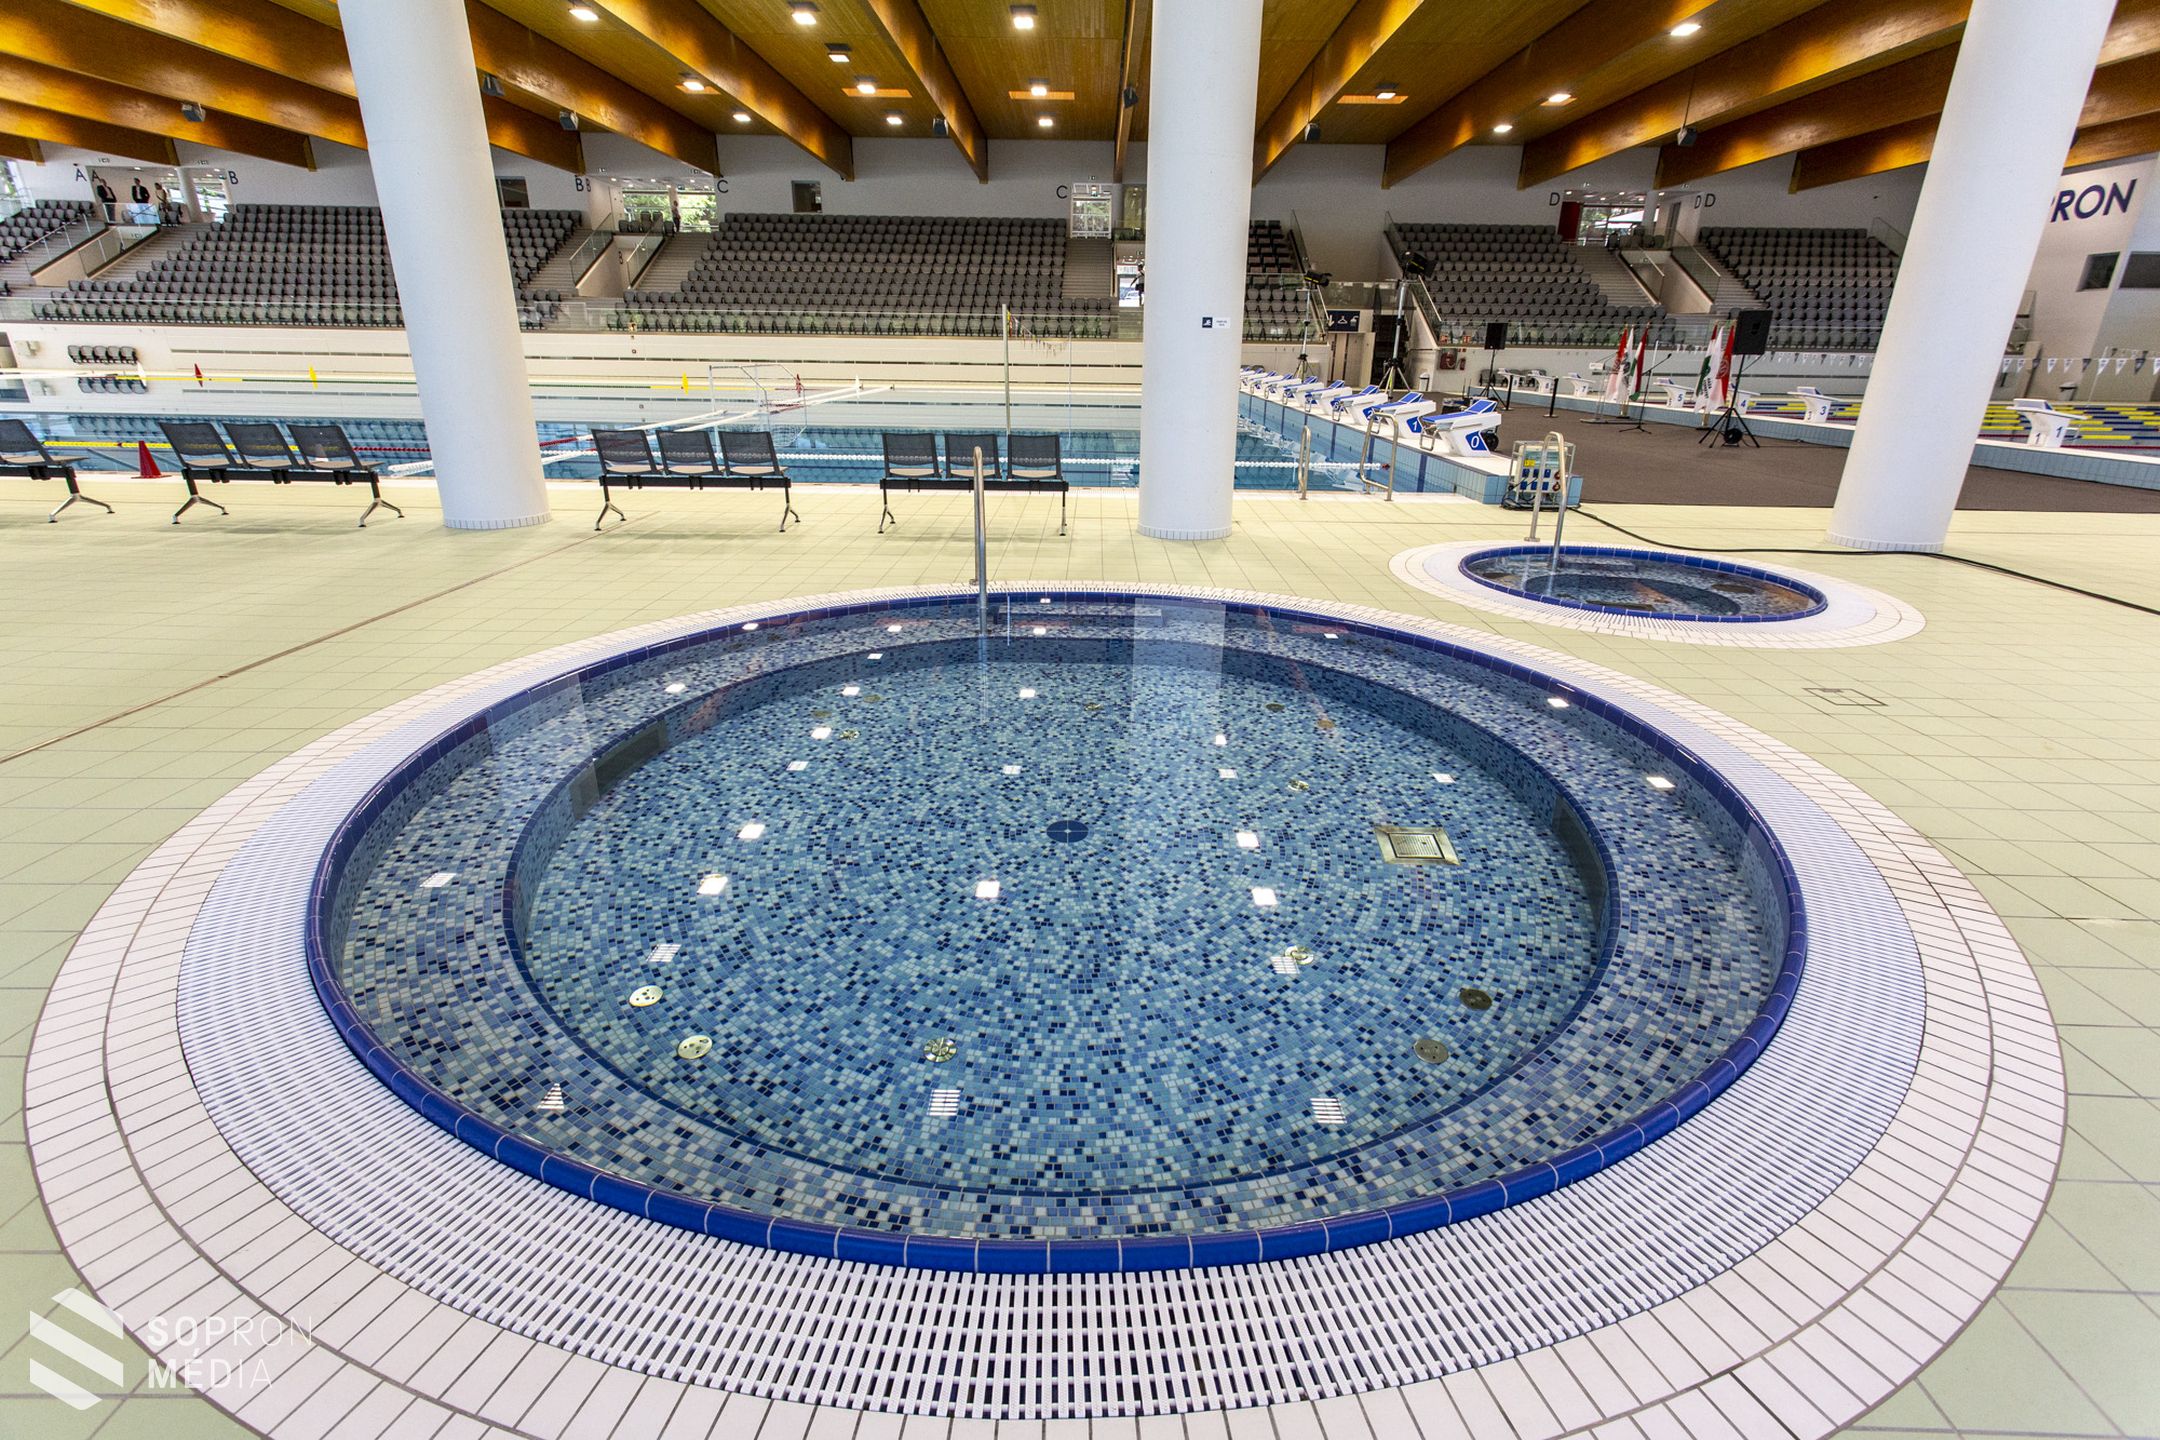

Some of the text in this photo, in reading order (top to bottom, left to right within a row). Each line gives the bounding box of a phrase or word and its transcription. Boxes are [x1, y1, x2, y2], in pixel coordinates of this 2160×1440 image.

[76, 168, 87, 182] A
[228, 170, 239, 184] B
[575, 177, 585, 192] B
[716, 179, 729, 193] C
[1056, 185, 1068, 199] C
[1549, 192, 1560, 206] D
[1694, 195, 1702, 209] D
[1704, 193, 1716, 207] D
[2050, 178, 2137, 222] RON
[1820, 406, 1827, 415] 3
[1412, 420, 1418, 431] 1
[2056, 427, 2063, 438] 1
[1471, 435, 1480, 449] 0
